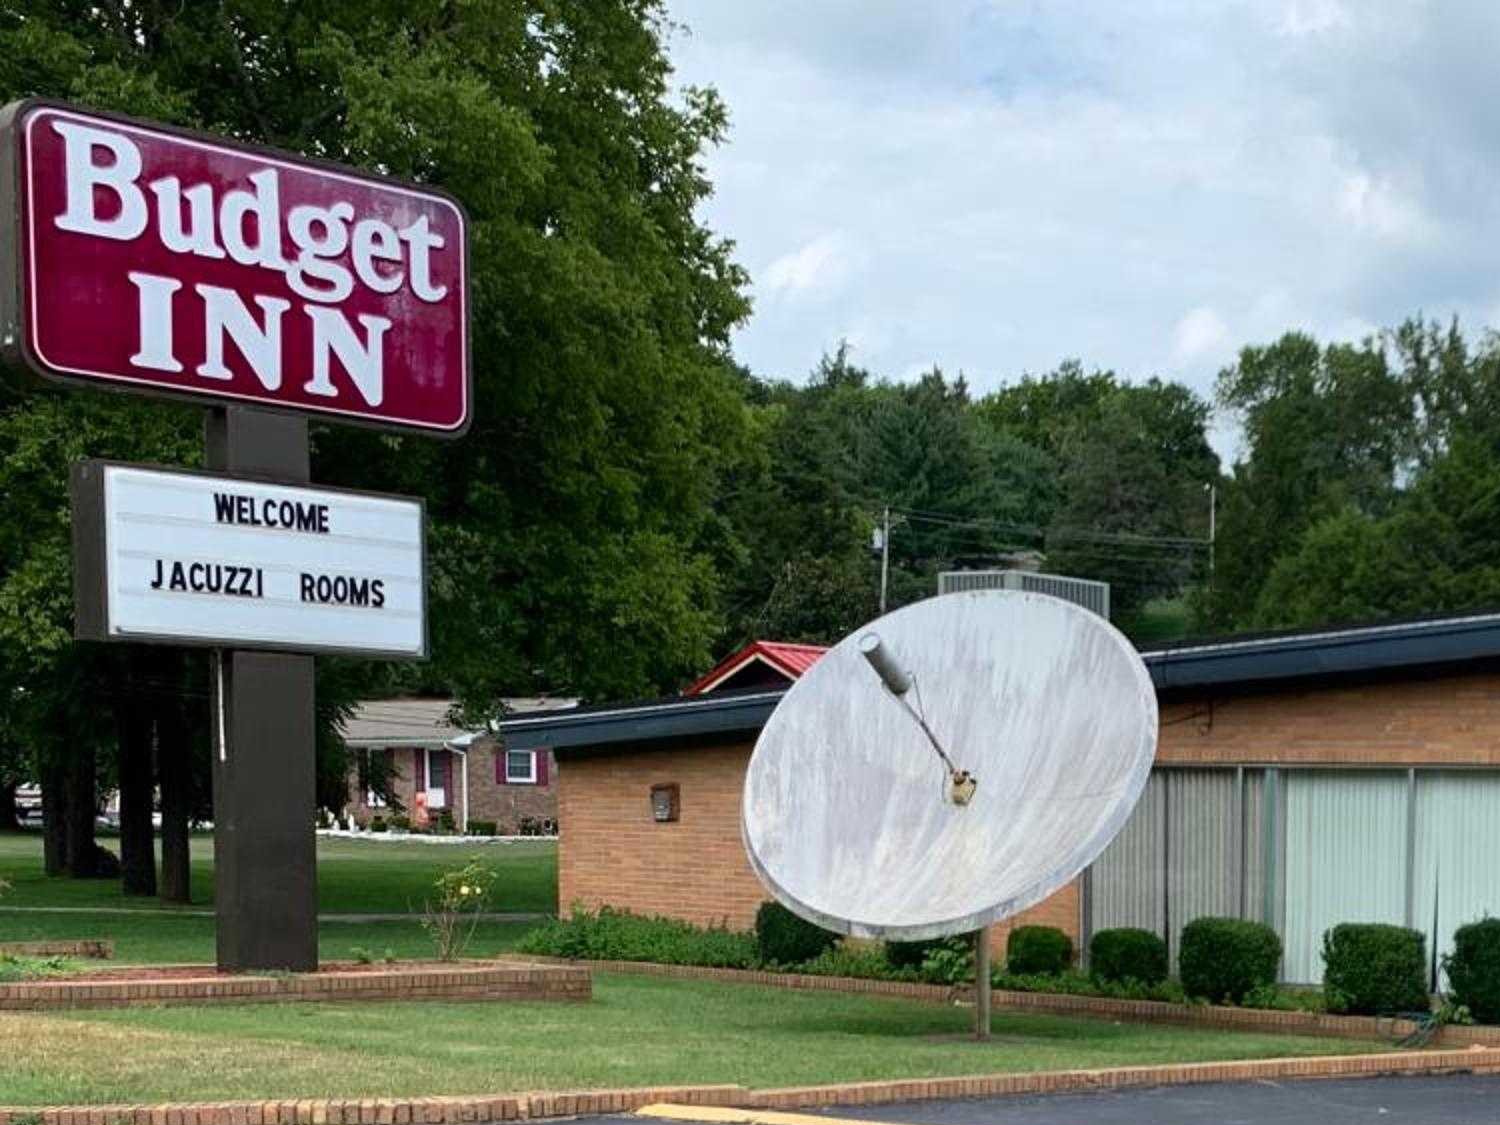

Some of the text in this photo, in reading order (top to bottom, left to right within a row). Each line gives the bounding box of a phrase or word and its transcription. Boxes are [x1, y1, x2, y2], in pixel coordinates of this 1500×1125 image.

[52, 121, 447, 302] Budget
[128, 272, 392, 407] INN
[214, 493, 329, 533] WELCOME
[150, 559, 385, 608] JACUZZI ROOMS
